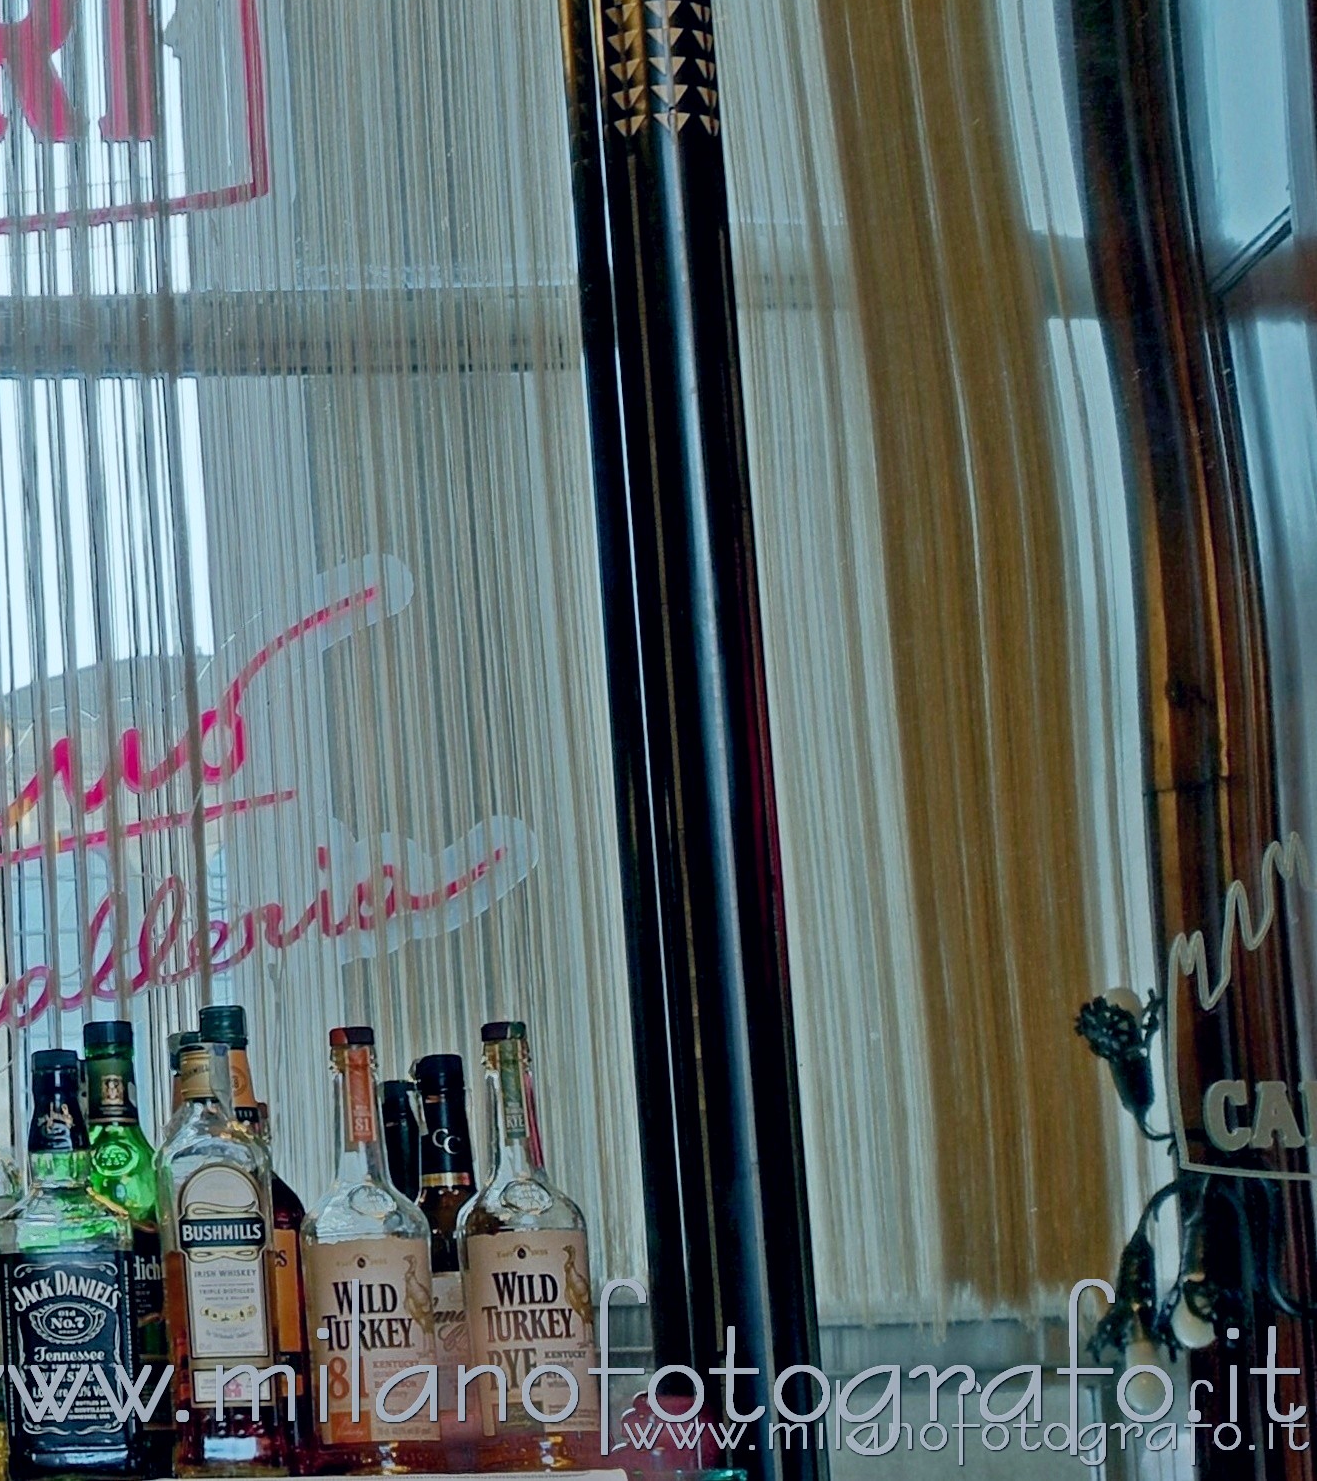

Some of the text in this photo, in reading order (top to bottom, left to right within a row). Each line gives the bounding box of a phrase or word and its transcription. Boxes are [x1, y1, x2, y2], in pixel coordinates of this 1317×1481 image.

[1203, 1080, 1317, 1151] CA
[182, 1225, 261, 1241] BUSHMILLS
[12, 1275, 56, 1312] JACK
[55, 1270, 123, 1312] DANIEL'S
[194, 1269, 256, 1278] IRISH WHISKEY
[492, 1271, 559, 1307] WILD
[332, 1280, 398, 1316] WILD
[322, 1314, 414, 1351] TURKEY
[482, 1306, 575, 1343] TURKEY
[34, 1347, 105, 1362] Tennessee
